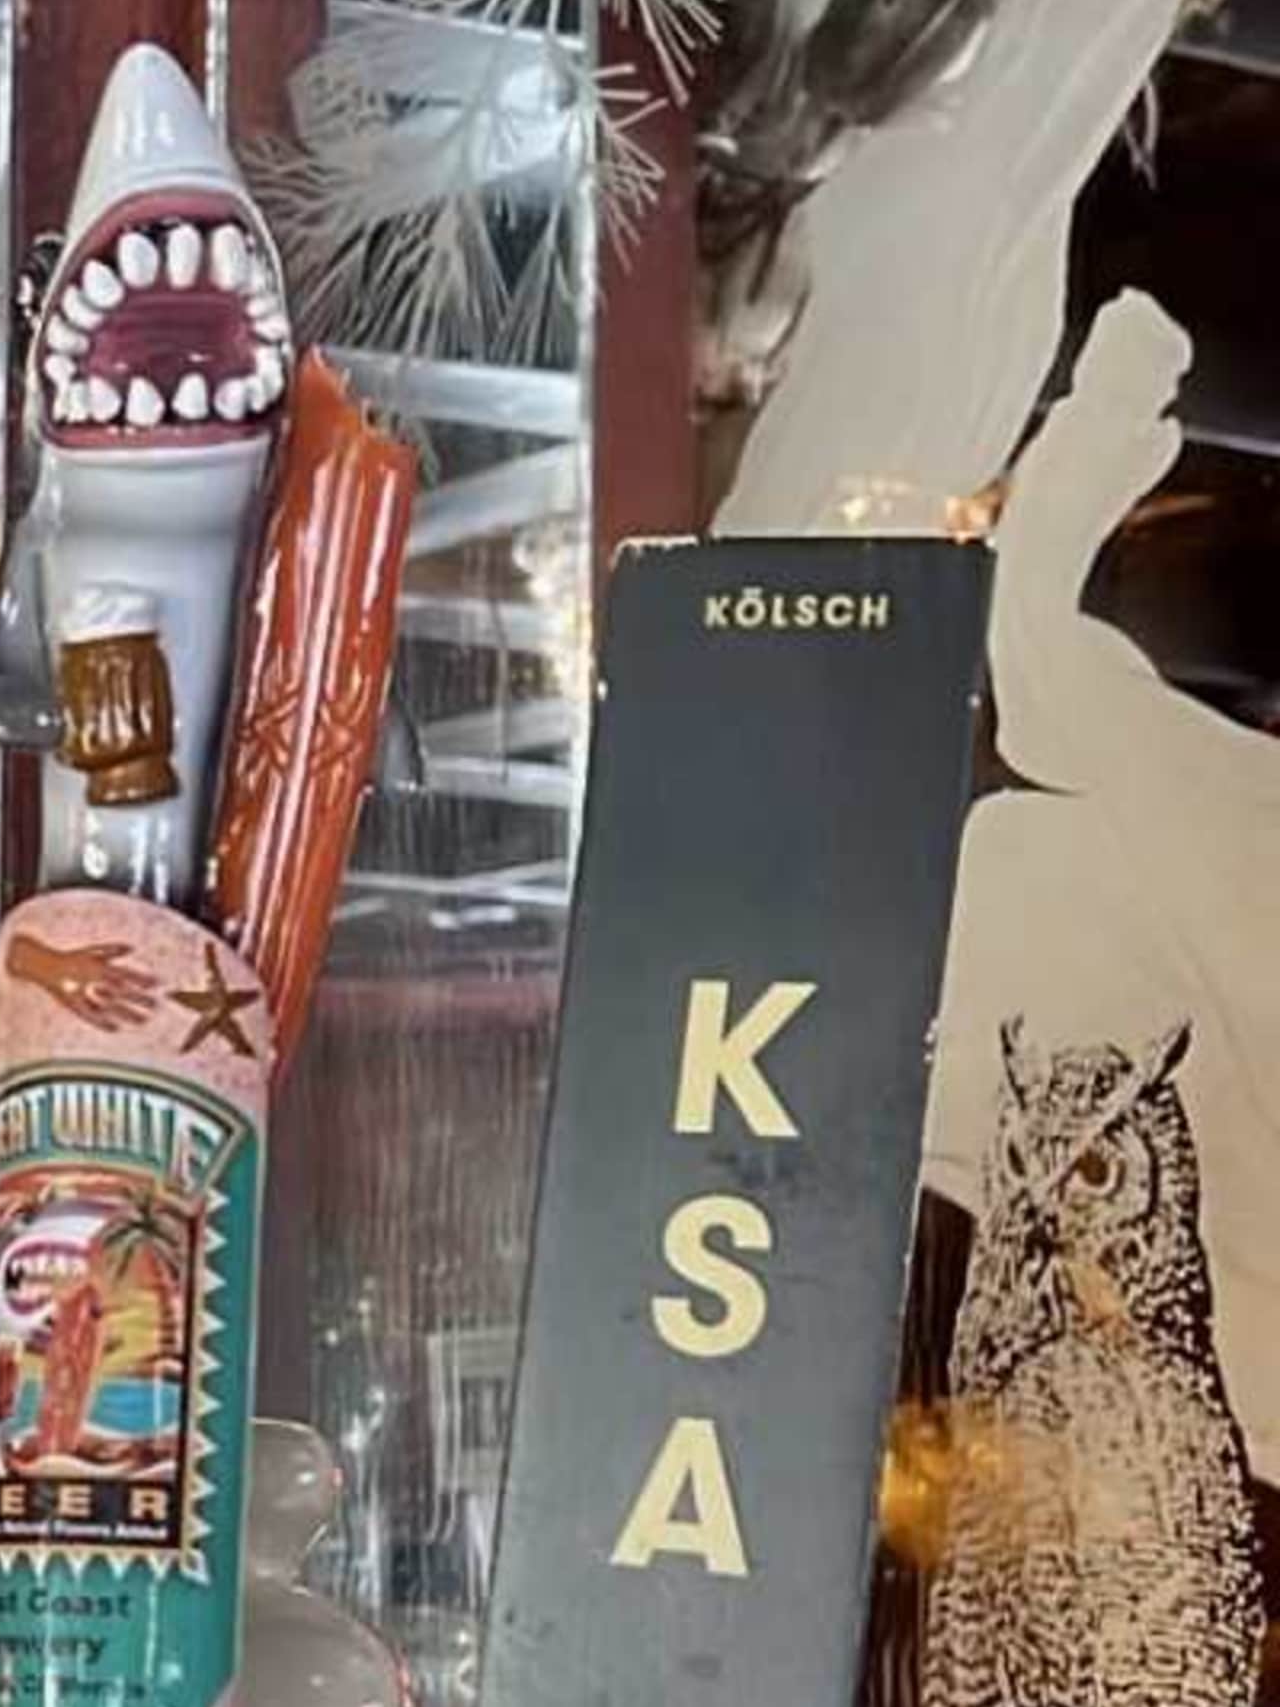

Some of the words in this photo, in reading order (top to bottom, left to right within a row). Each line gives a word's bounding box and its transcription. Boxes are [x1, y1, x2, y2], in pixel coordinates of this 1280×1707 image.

[704, 591, 891, 628] KÖLSCH
[52, 1082, 230, 1191] WHITE
[607, 980, 819, 1577] KSA
[0, 1483, 169, 1520] EER
